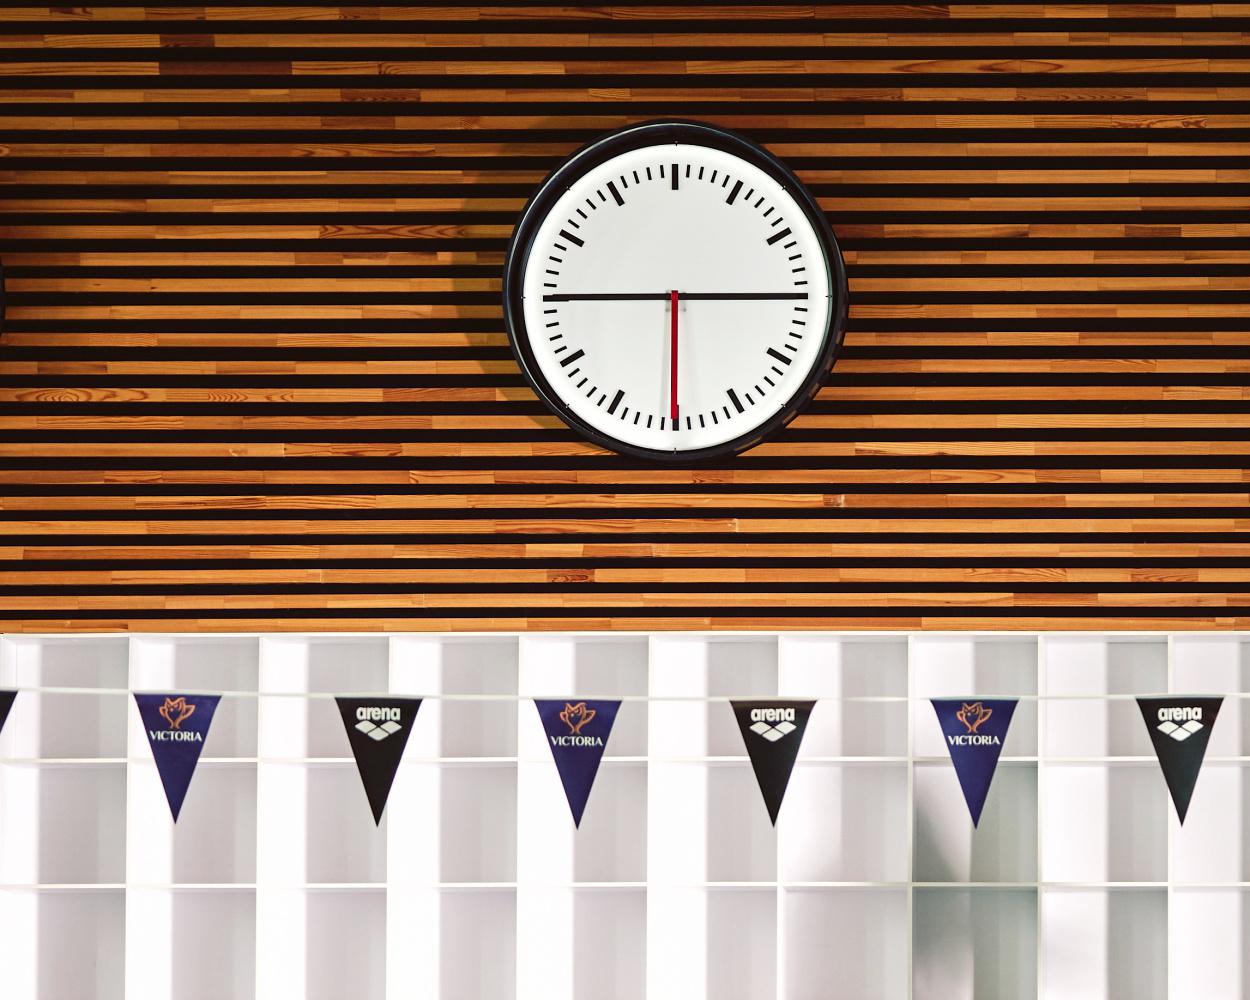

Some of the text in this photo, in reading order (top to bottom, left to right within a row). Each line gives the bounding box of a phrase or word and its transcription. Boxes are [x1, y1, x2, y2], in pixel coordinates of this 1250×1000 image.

[356, 706, 401, 721] arena
[750, 707, 795, 722] arena
[1158, 706, 1203, 721] arena
[150, 730, 203, 742] VICTORIA
[550, 735, 604, 747] VICTORIA
[948, 735, 1000, 746] VICTORIA
